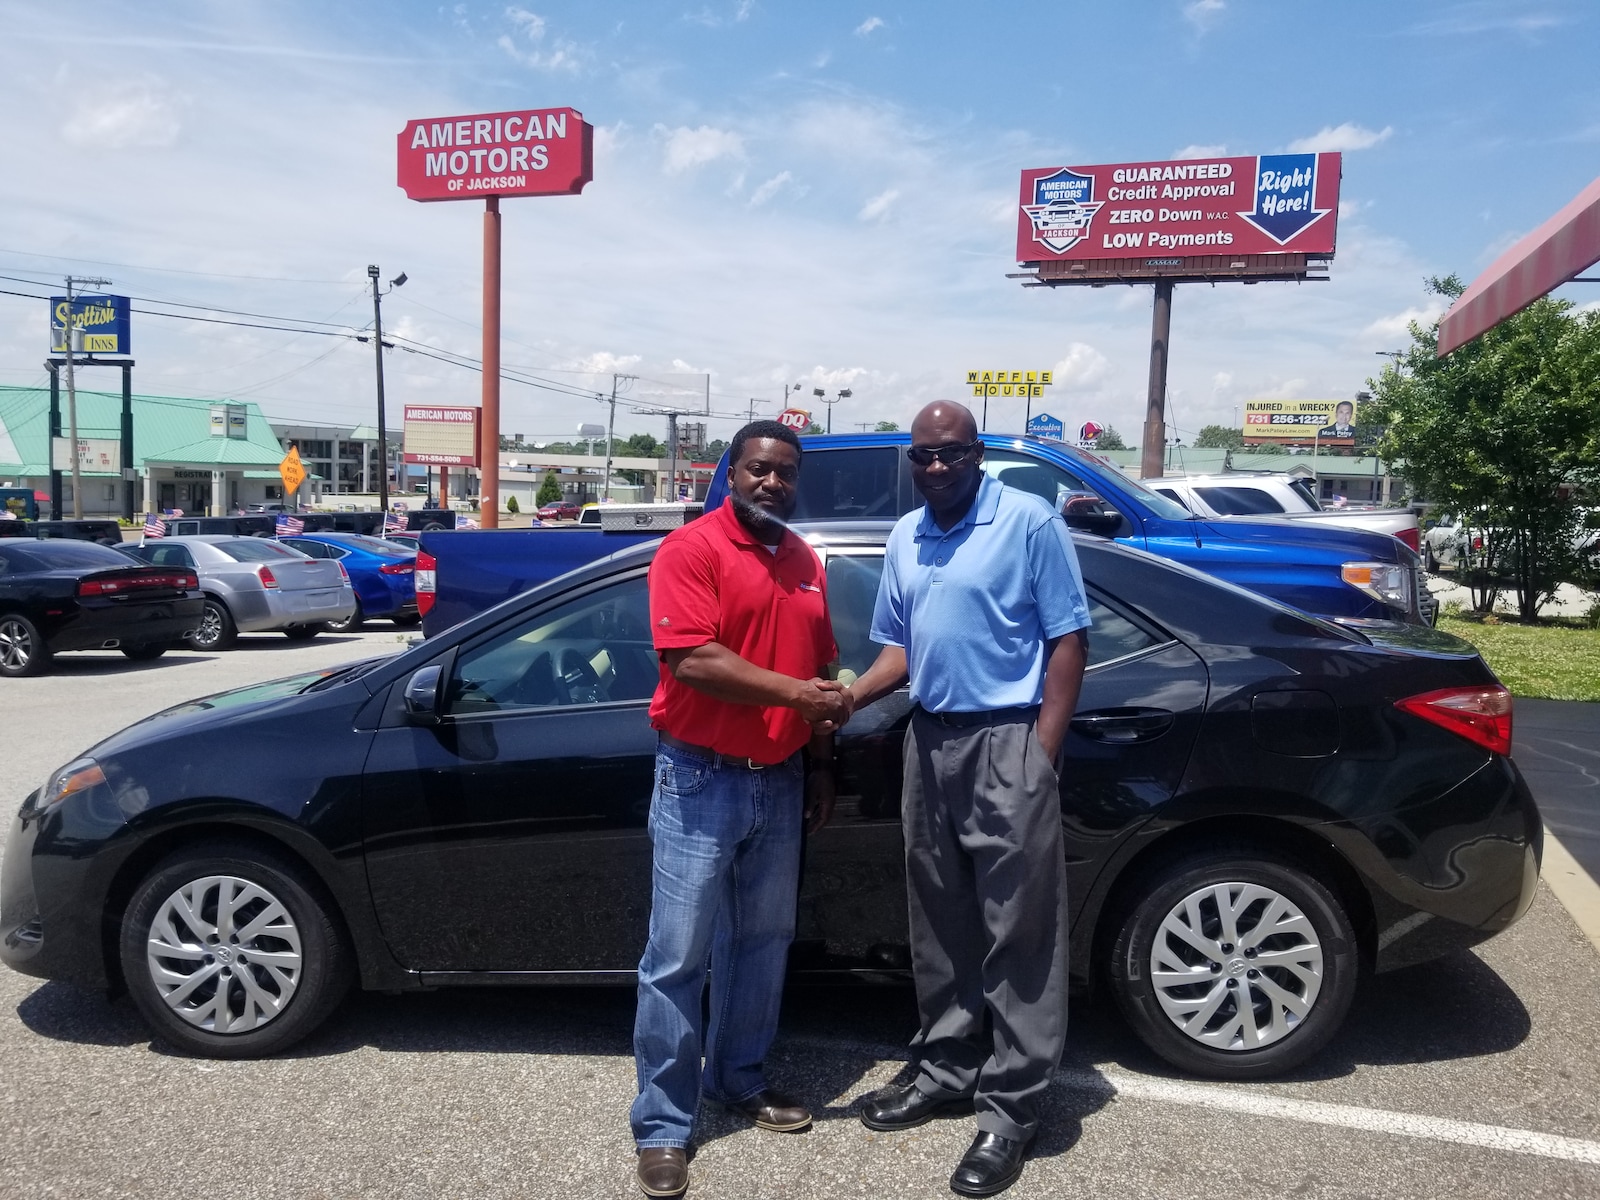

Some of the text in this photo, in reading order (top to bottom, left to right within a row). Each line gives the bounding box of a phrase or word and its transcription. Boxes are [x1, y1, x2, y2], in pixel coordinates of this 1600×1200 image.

[410, 112, 568, 150] AMERICAN
[425, 144, 550, 178] MOTORS
[1112, 163, 1233, 184] GUARANTEED
[1258, 166, 1312, 194] Right
[447, 175, 527, 191] OF JACKSON
[1040, 180, 1088, 191] AMERICAN
[1044, 190, 1083, 200] MOTORS
[1107, 181, 1236, 201] Credit Approval
[1261, 190, 1310, 217] Here!
[1108, 209, 1155, 224] ZERO
[1158, 208, 1203, 222] Down
[1042, 229, 1079, 238] JACKSON
[1103, 230, 1235, 250] LOW Payments
[91, 337, 114, 350] INNS
[968, 372, 1050, 382] WAFFLE
[974, 386, 1041, 396] HOUSE
[1246, 403, 1283, 411] INJURED
[1299, 403, 1336, 411] WRECK?
[407, 409, 473, 421] AMERICAN MOTORS
[781, 413, 805, 428] DQ
[1249, 415, 1269, 424] 731
[416, 455, 461, 463] 731-554-5000
[174, 471, 213, 479] REGISTRATI
